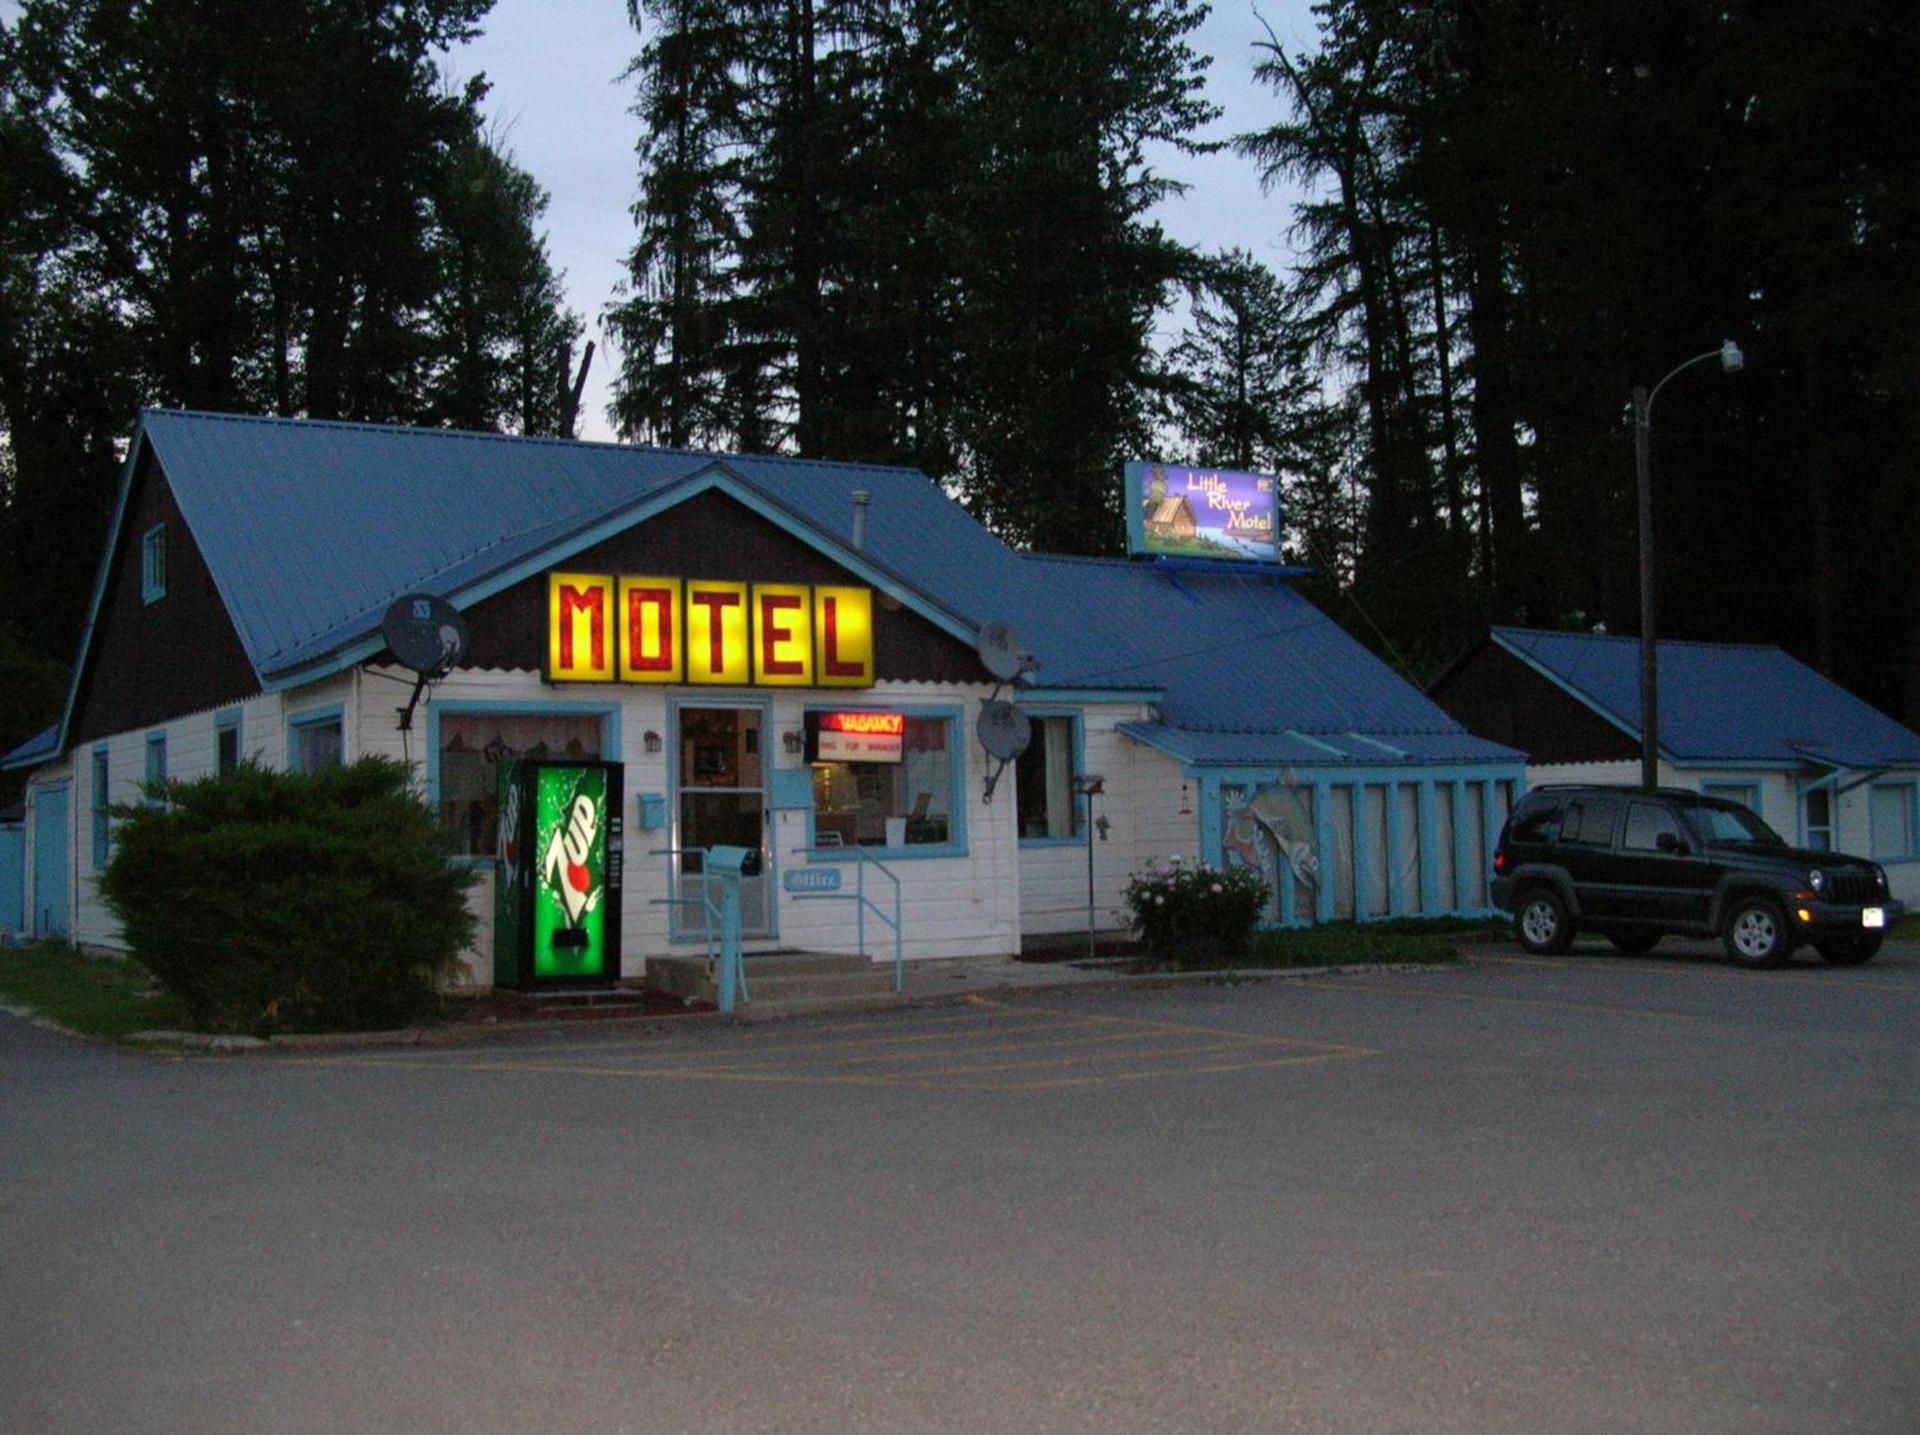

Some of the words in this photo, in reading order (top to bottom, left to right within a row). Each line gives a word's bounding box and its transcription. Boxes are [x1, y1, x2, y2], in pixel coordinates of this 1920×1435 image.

[1188, 472, 1227, 493] Little
[1206, 491, 1250, 511] River
[1227, 511, 1271, 530] Motel
[558, 584, 865, 677] MOTEL
[840, 713, 902, 733] VACANCY
[545, 794, 596, 924] 7UP
[790, 871, 835, 887] Office
